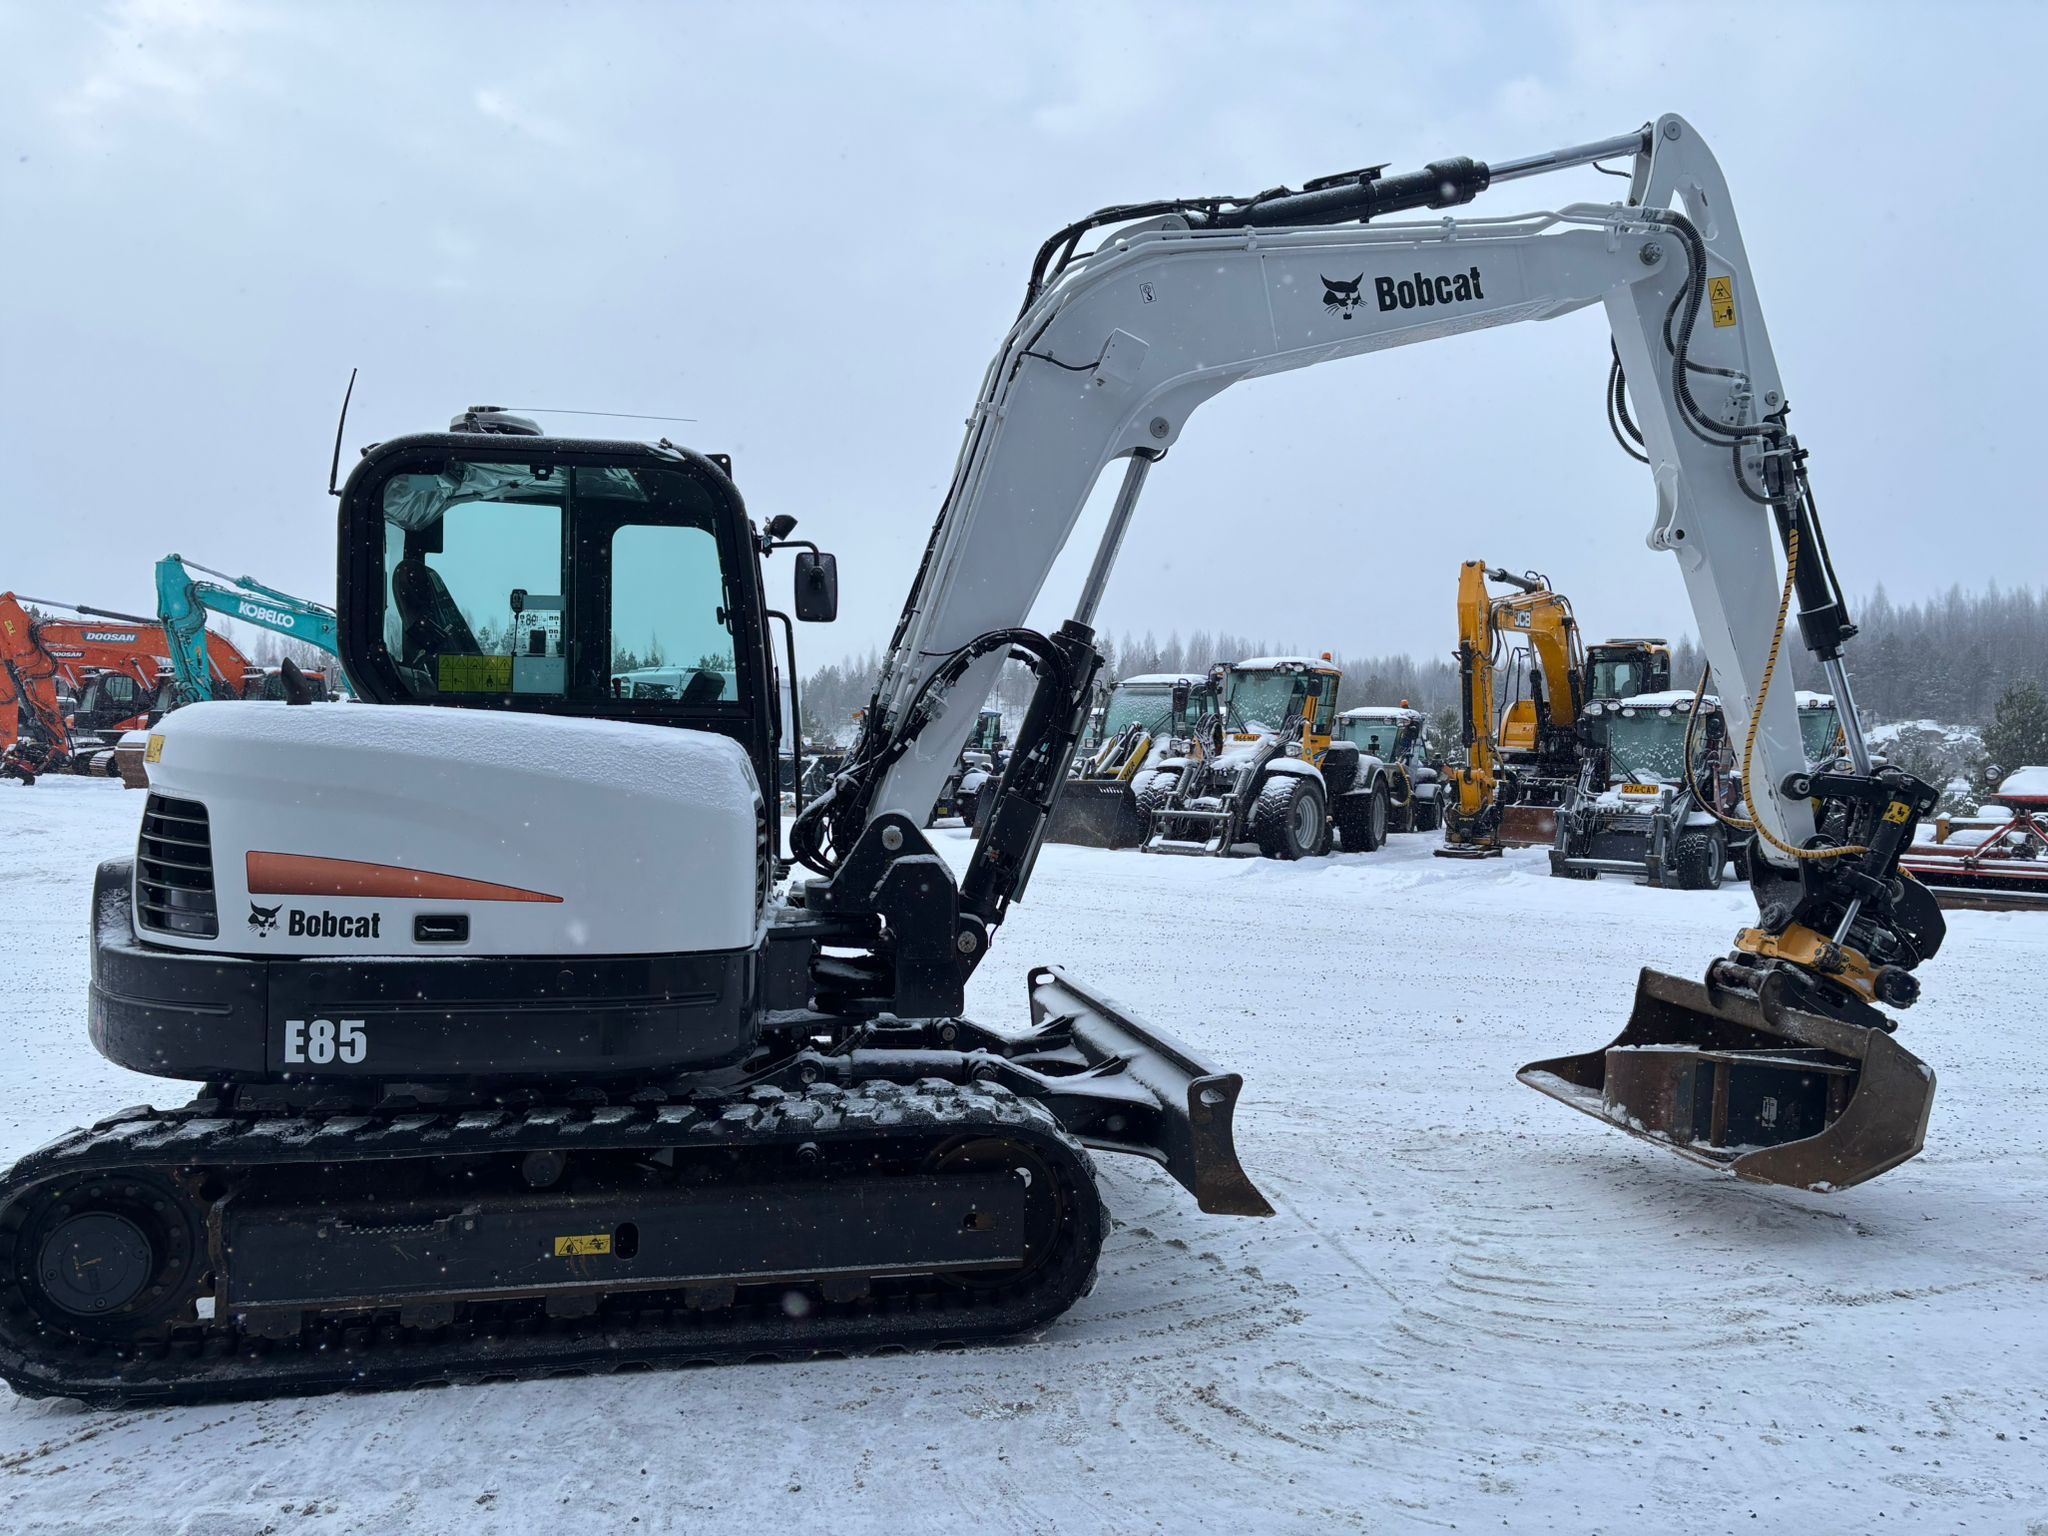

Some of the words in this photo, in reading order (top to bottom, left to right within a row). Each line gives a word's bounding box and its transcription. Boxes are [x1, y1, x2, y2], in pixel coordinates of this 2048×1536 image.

[1375, 266, 1484, 312] Bobcat
[238, 600, 295, 628] KOBELCO
[1514, 611, 1531, 627] JCB
[86, 632, 136, 642] DOOSAN
[288, 909, 380, 939] Bobcat
[284, 1019, 367, 1064] E85
